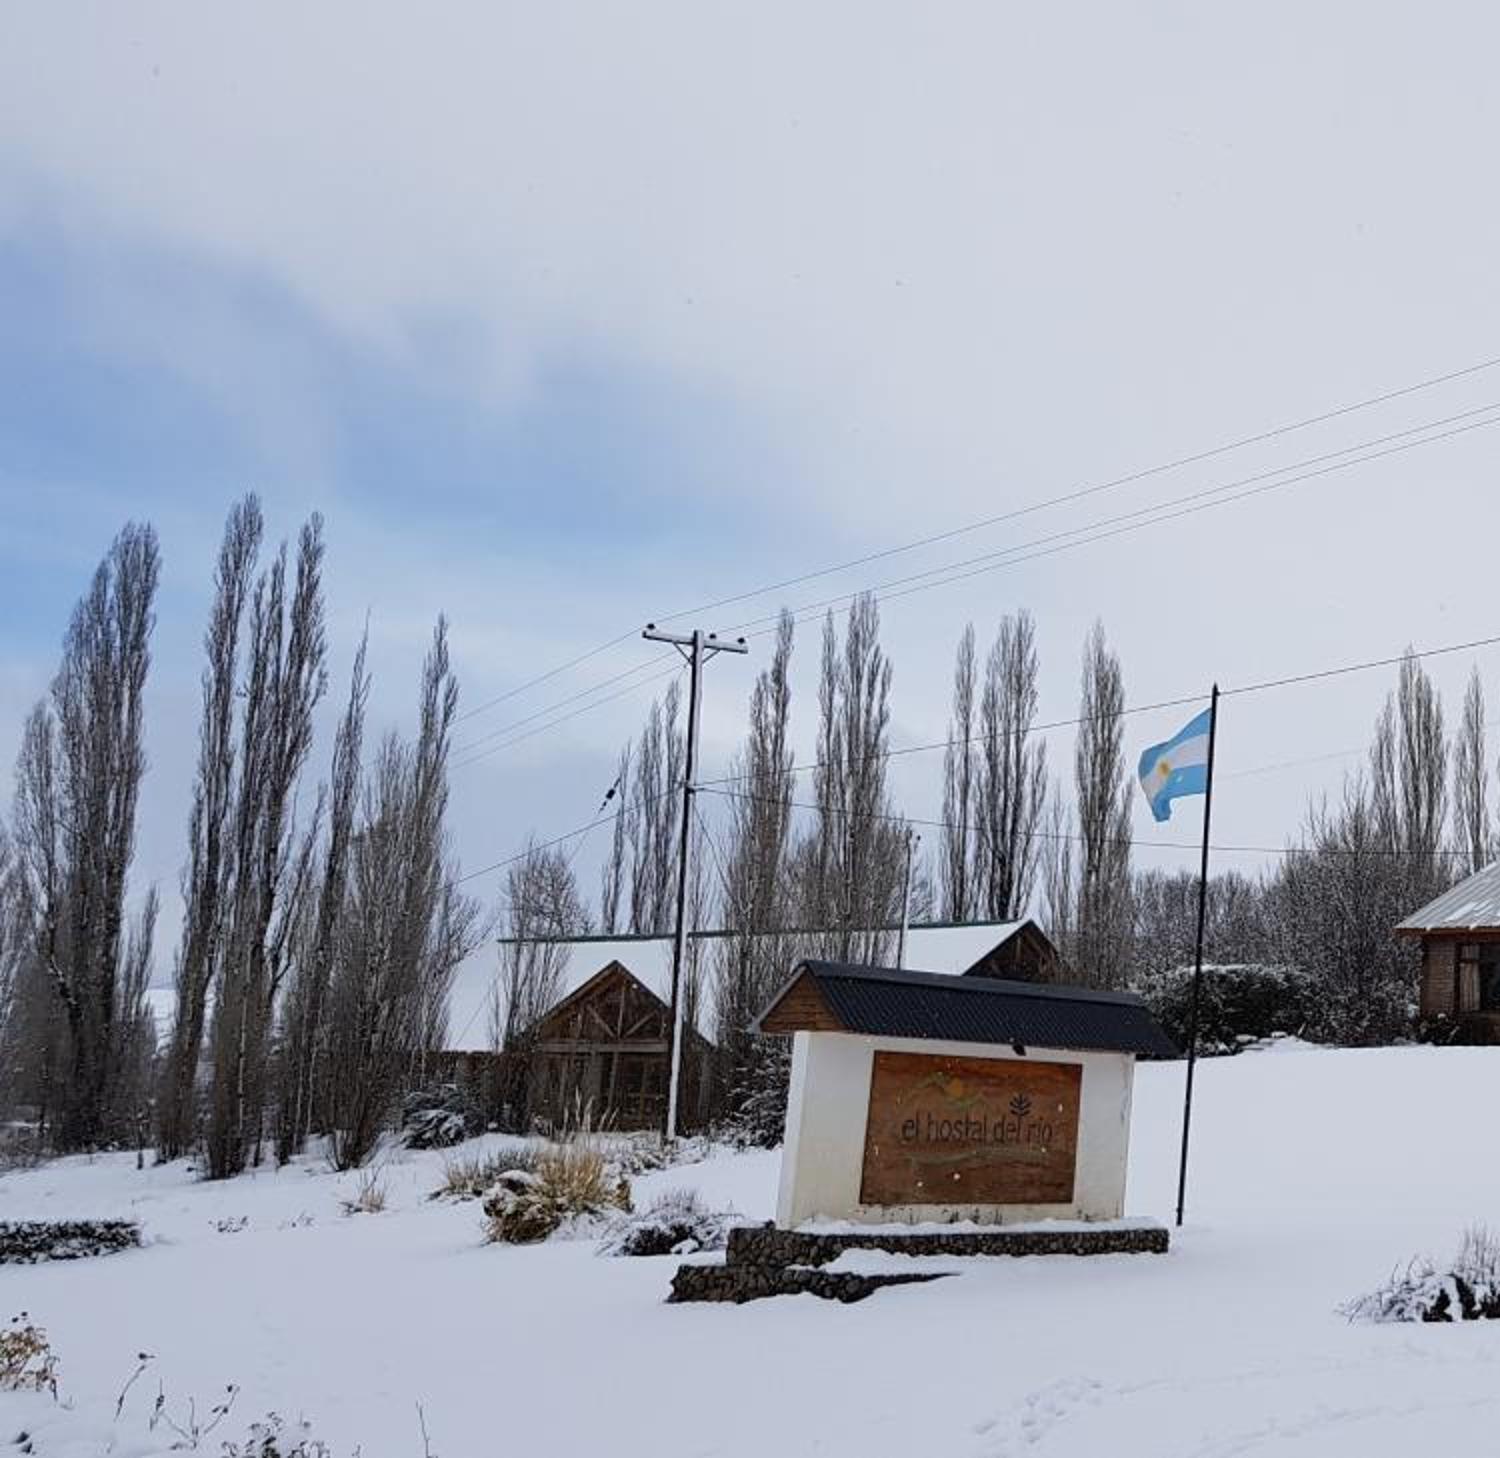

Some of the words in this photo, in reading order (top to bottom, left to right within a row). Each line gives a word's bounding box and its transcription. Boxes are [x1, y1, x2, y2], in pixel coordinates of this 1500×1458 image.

[902, 1111, 919, 1141] el
[927, 1111, 986, 1143] hostal
[993, 1110, 1021, 1144] del
